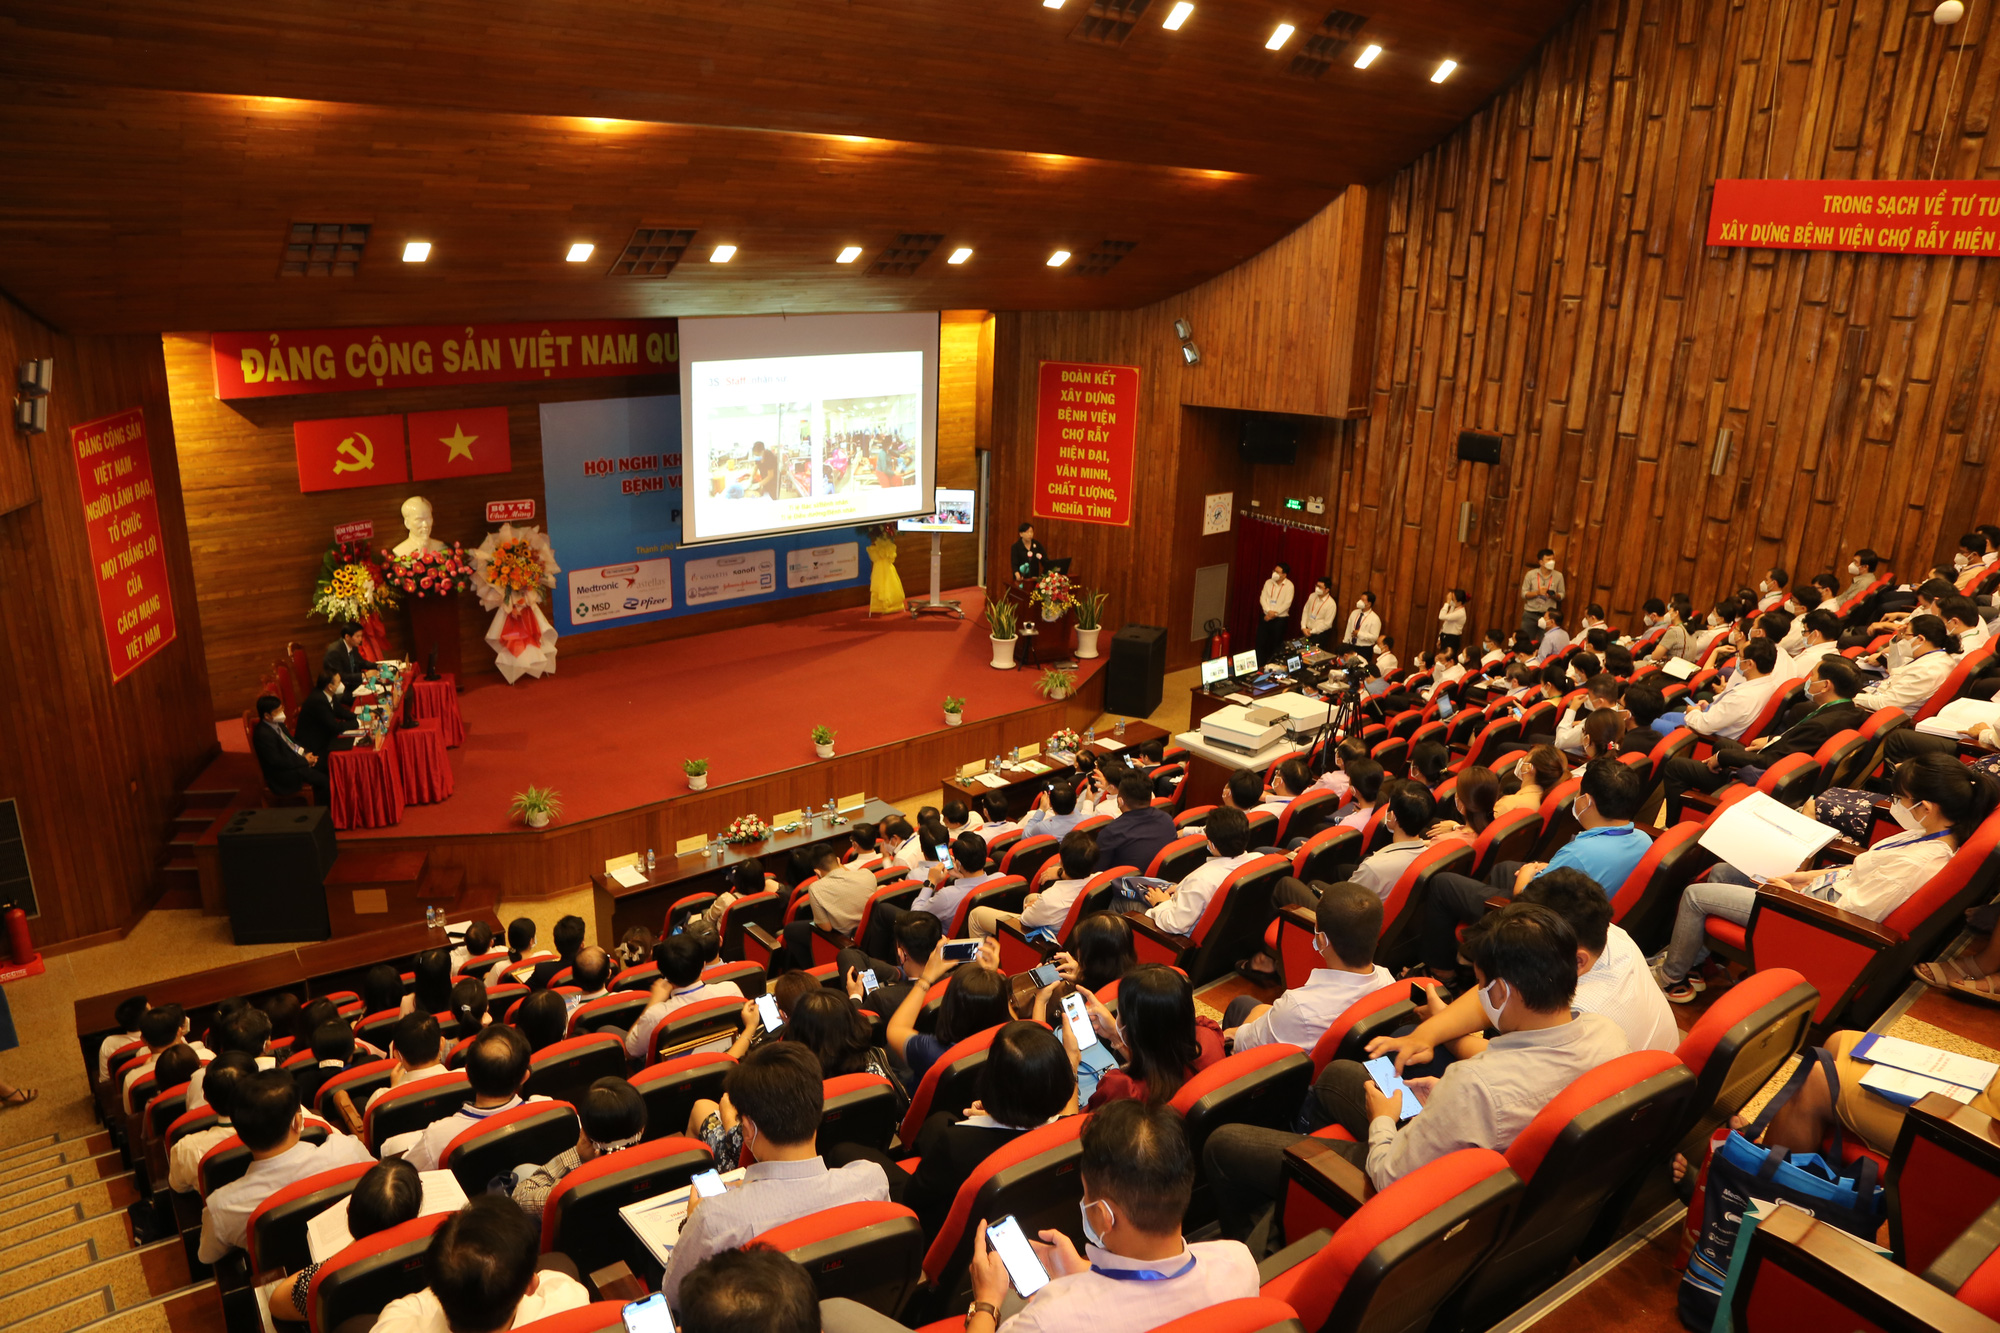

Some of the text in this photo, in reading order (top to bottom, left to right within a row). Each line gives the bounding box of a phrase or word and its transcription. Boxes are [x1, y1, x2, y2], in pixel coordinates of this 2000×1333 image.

[1823, 194, 1872, 214] TRONG
[1876, 196, 1918, 218] SẠCH
[1924, 188, 1948, 216] VỀ
[1952, 194, 1977, 216] TƯ
[1720, 219, 1996, 254] XÂY DỰNG BỆNH VIỆN CHỢ RẪY HIỆN
[241, 327, 679, 386] ĐẢNG CỘNG SẢN VIỆT NAM QU
[1061, 369, 1116, 386] ĐOÀN KẾT
[1060, 388, 1116, 406] XÂY DỰNG
[1058, 406, 1116, 426] BỆNH VIỆN
[78, 417, 142, 458] ĐẢNG CỘNG SẢN
[1062, 426, 1110, 442] CHỢ RẪY
[1059, 444, 1110, 464] HIỆN ĐẠI,
[93, 460, 113, 486] VIỆT
[114, 456, 132, 478] NAM
[584, 458, 614, 477] HỘI
[618, 455, 658, 472] NGHỊ
[1056, 463, 1111, 482] VĂN MINH,
[621, 476, 664, 496] BỆNH
[1048, 480, 1118, 502] CHẤT LƯỢNG,
[86, 479, 153, 522] NGƯỜI LÃNH ĐẠO,
[1052, 501, 1112, 518] NGHĨA TÌNH
[108, 510, 142, 544] TỔ CHỨC
[101, 534, 157, 581] MỌI THẮNG LỢI
[733, 566, 756, 575] sanofi
[126, 572, 143, 598] CỦA
[576, 582, 619, 594] Medtronic
[636, 577, 666, 589] astellas
[591, 602, 611, 612] MSD
[640, 597, 667, 609] Pfizer
[117, 594, 161, 635] CÁCH MẠNG
[125, 624, 161, 661] VIỆT NAM
